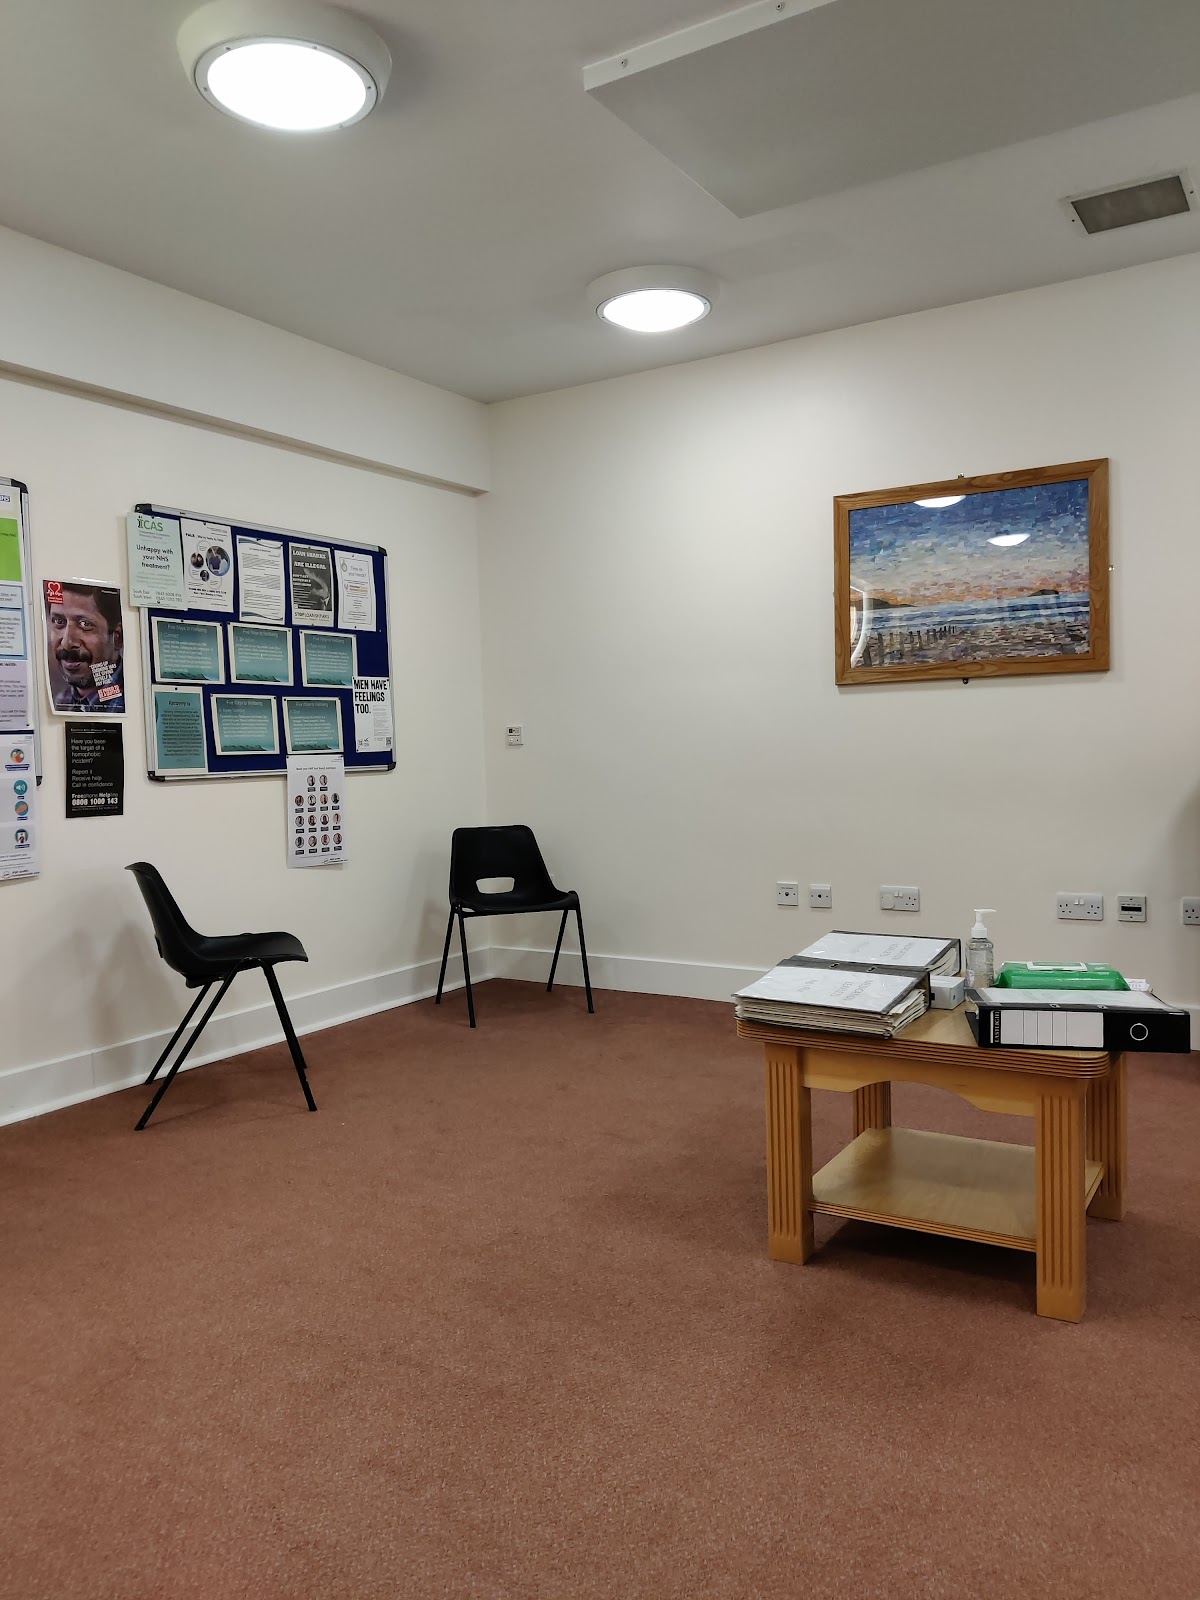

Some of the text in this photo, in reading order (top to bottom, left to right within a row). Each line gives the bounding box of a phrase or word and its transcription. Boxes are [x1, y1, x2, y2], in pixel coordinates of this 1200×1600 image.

[136, 544, 160, 554] Unhappy
[292, 549, 306, 557] LOAN
[141, 562, 170, 570] treatment?
[304, 562, 327, 570] ILLEGAL
[353, 679, 388, 690] MEN HAVE
[354, 691, 385, 702] FEELINGS
[355, 703, 371, 714] TOO.
[80, 744, 95, 752] target
[71, 798, 88, 806] 0808
[107, 797, 118, 805] 143
